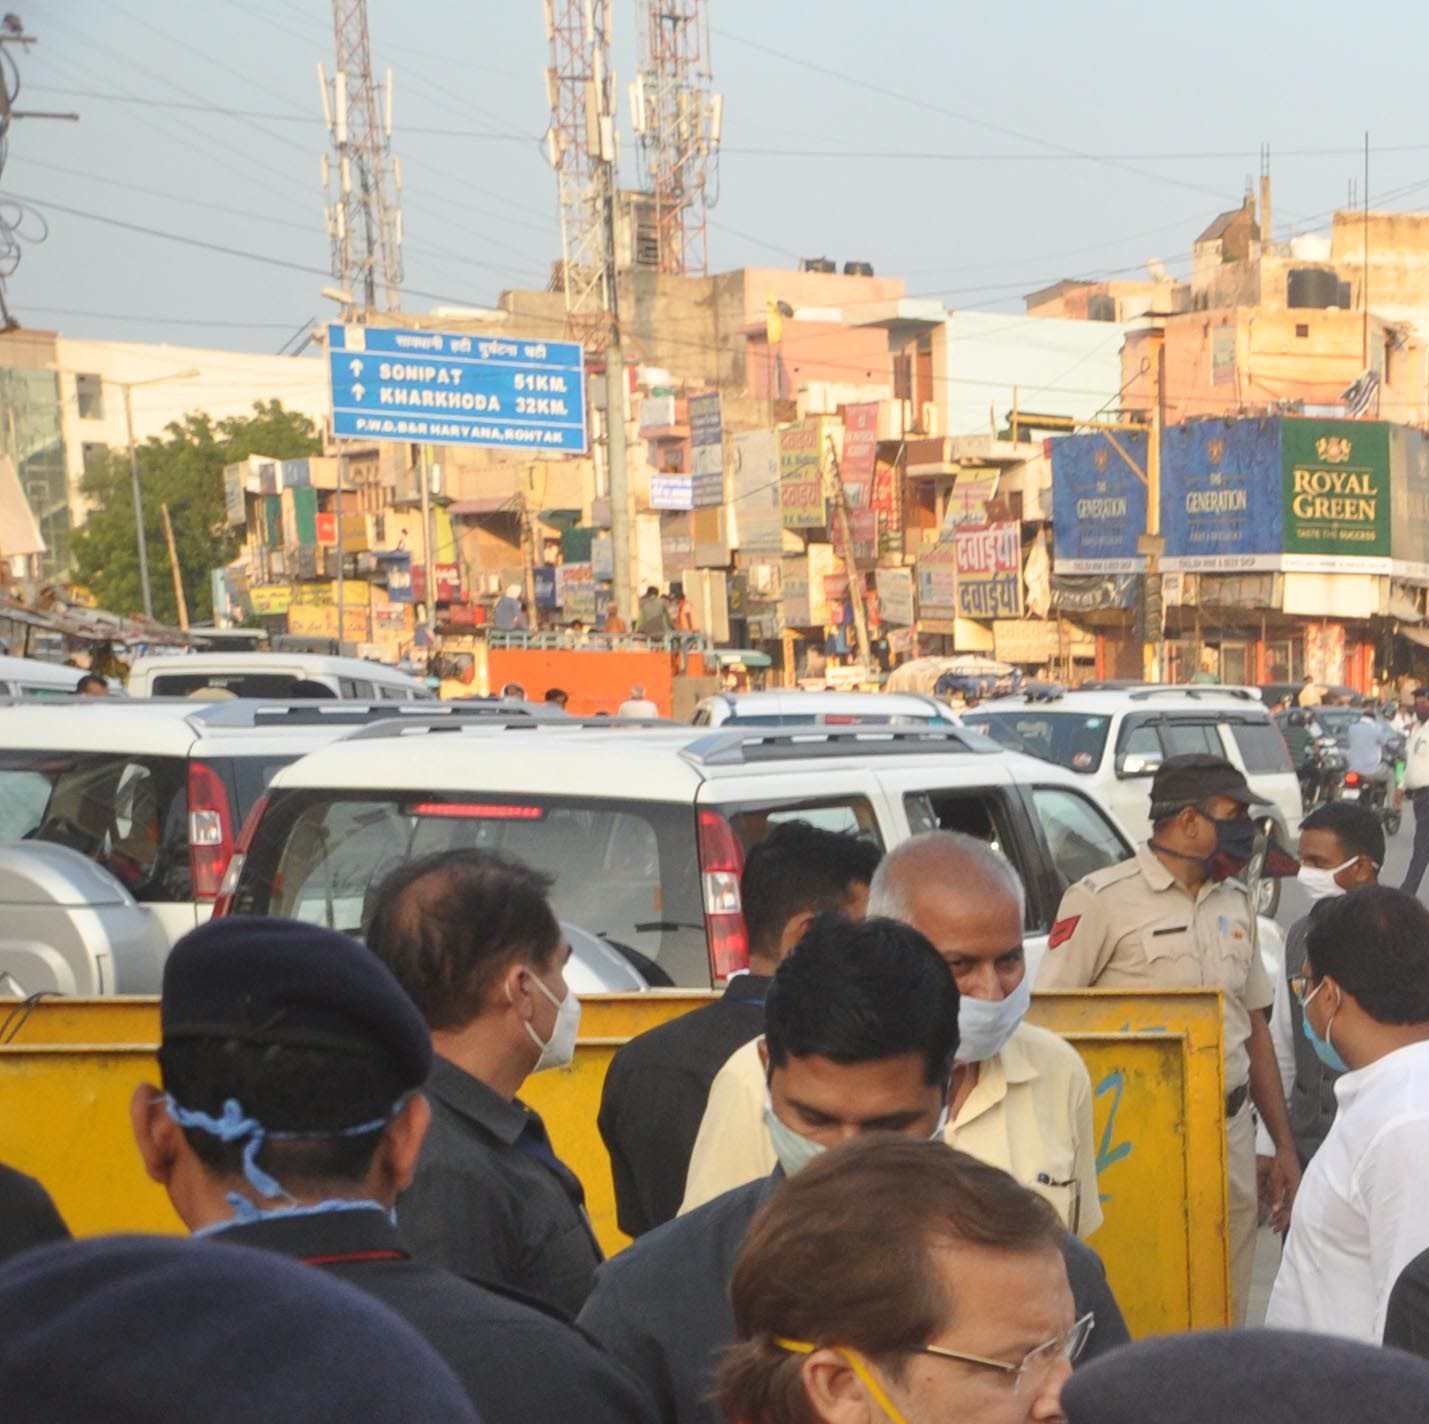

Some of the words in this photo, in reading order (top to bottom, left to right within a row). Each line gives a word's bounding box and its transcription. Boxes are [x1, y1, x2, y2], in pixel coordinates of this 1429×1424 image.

[379, 362, 463, 385] SONIPAT
[379, 386, 501, 412] KHARKHODA
[1292, 469, 1378, 496] ROYAL
[1077, 497, 1127, 519] GENERATION
[1186, 489, 1247, 514] GENERATION
[1292, 493, 1377, 521] GREEN
